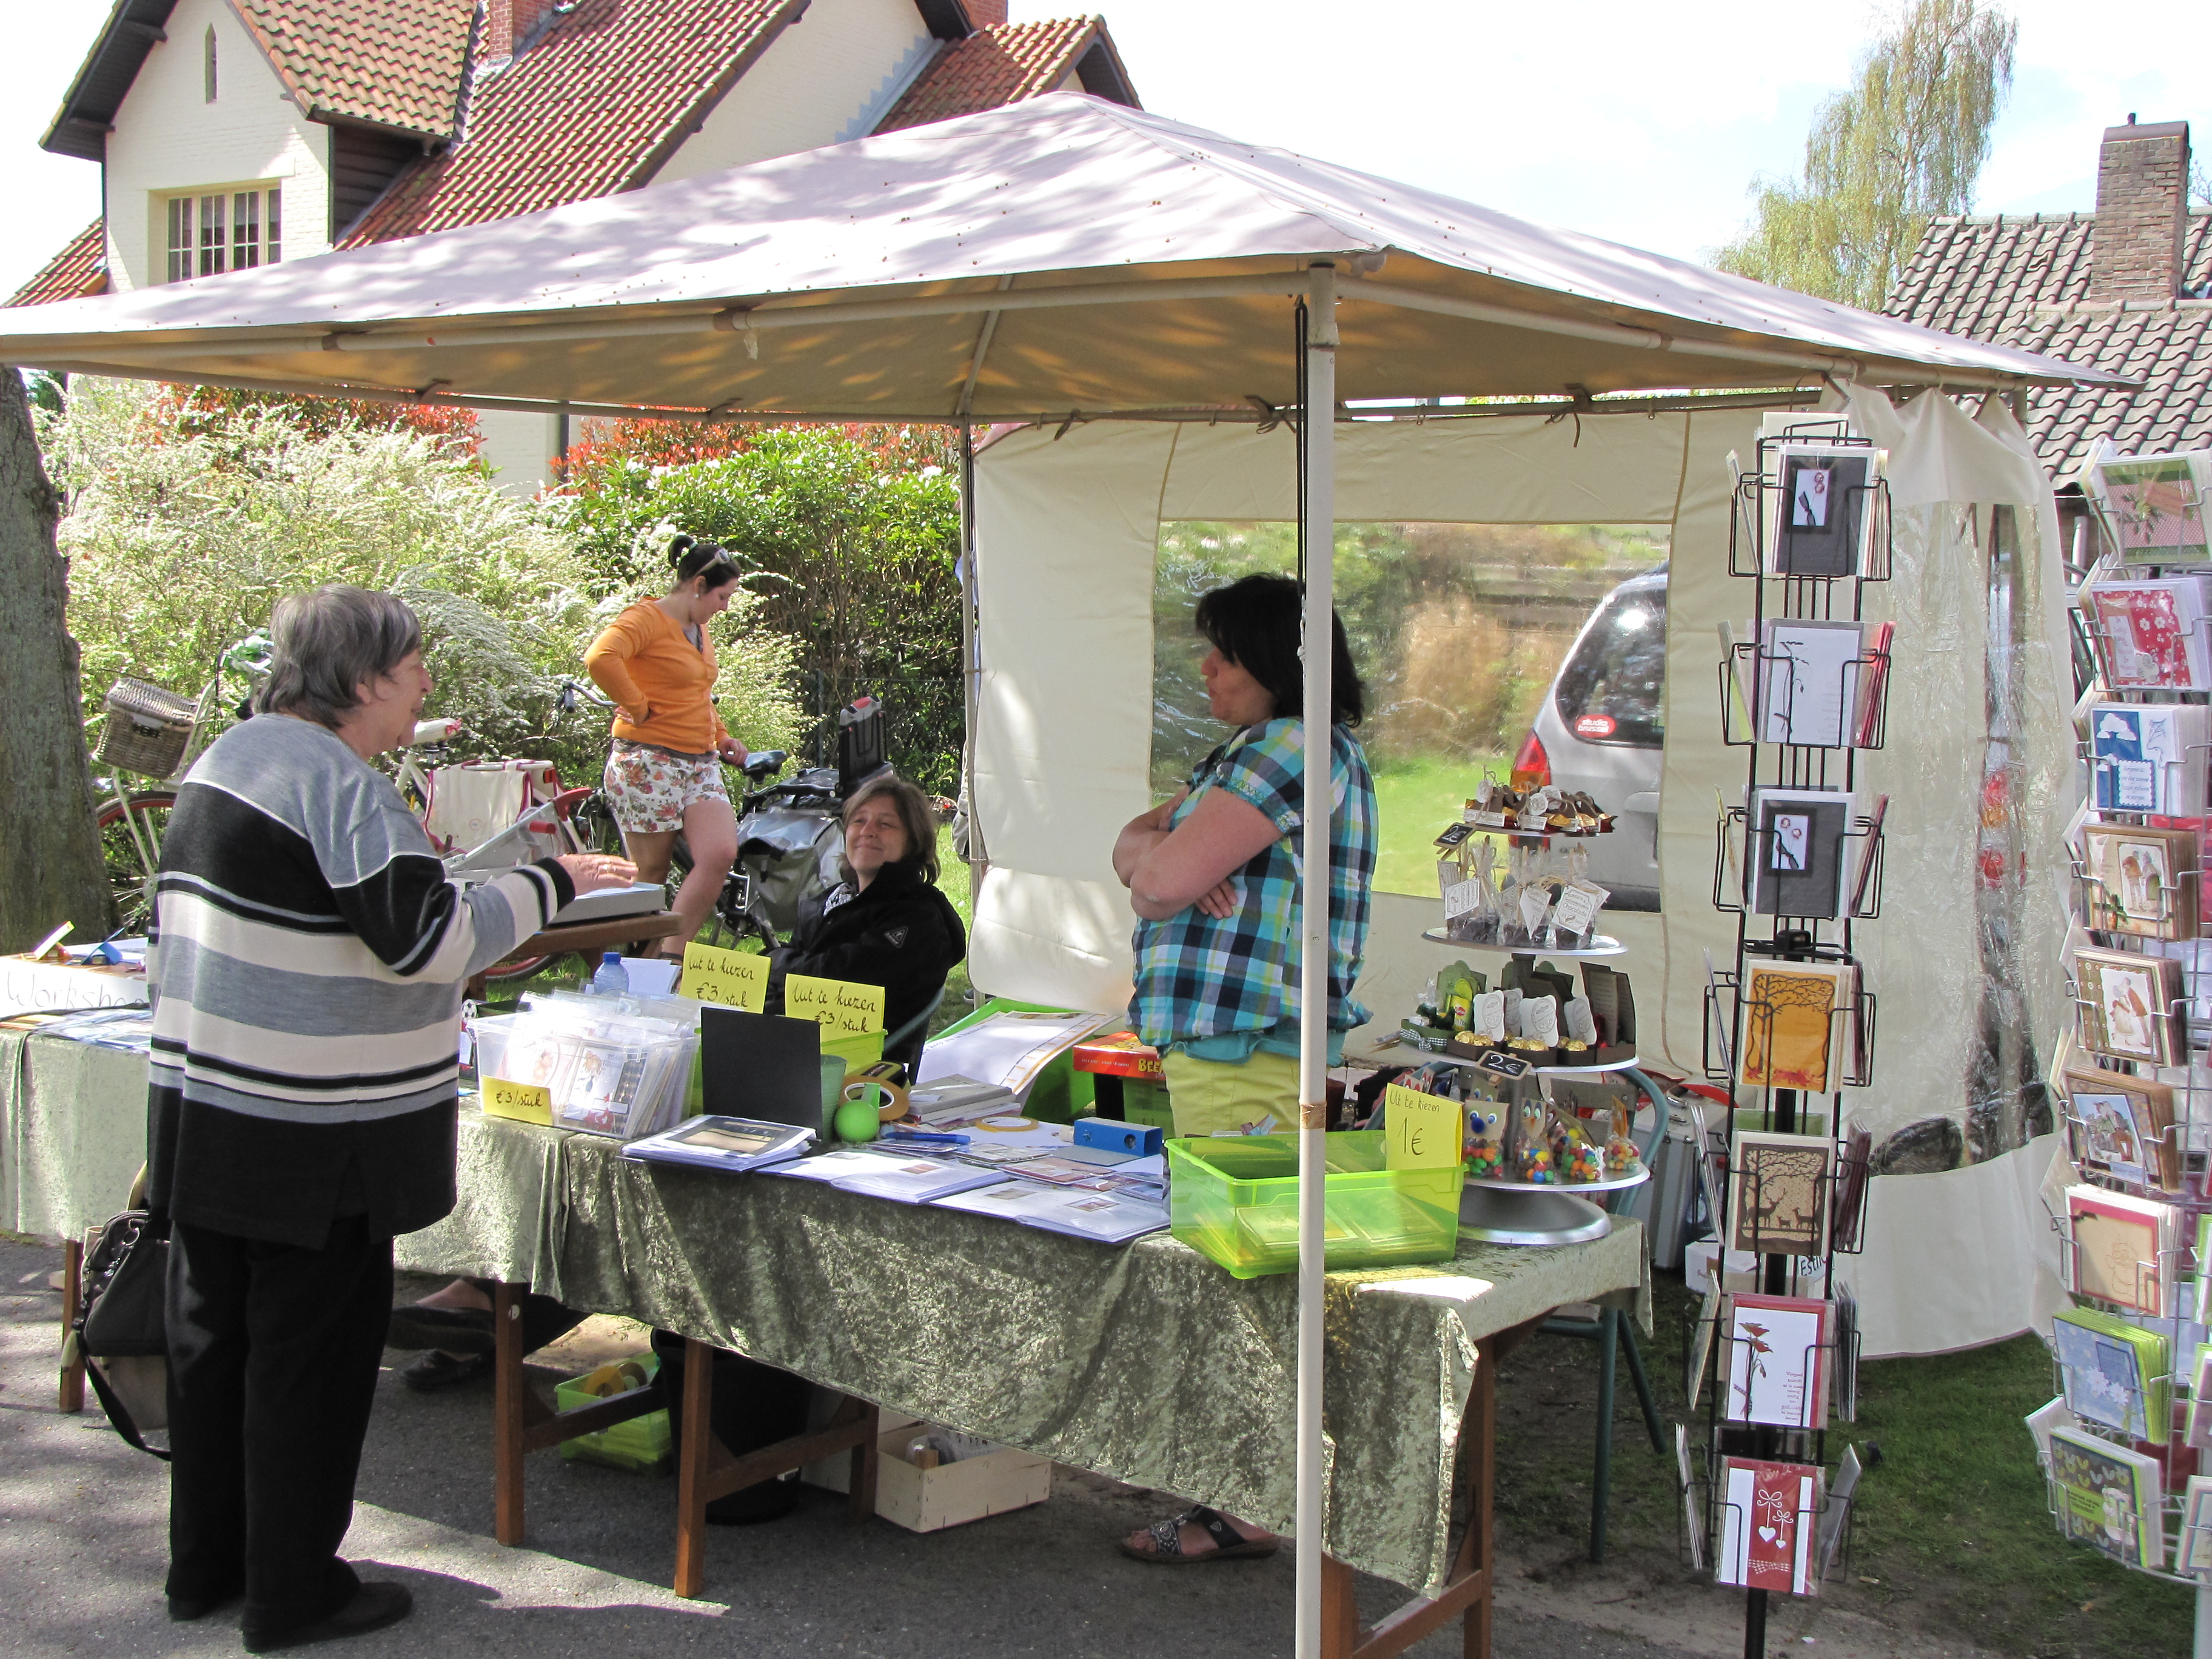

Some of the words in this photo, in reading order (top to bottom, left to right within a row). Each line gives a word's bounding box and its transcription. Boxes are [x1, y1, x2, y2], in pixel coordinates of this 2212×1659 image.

[1441, 825, 1467, 842] 2€
[708, 958, 716, 971] te
[720, 957, 754, 980] kiezen
[793, 983, 813, 1003] Uit
[817, 989, 828, 1004] te
[834, 986, 876, 1013] kiezen
[1488, 1055, 1521, 1074] 2€
[1390, 1090, 1401, 1107] Uit
[1404, 1094, 1413, 1108] te
[1418, 1096, 1440, 1113] kiezen
[1397, 1117, 1426, 1156] 1€
